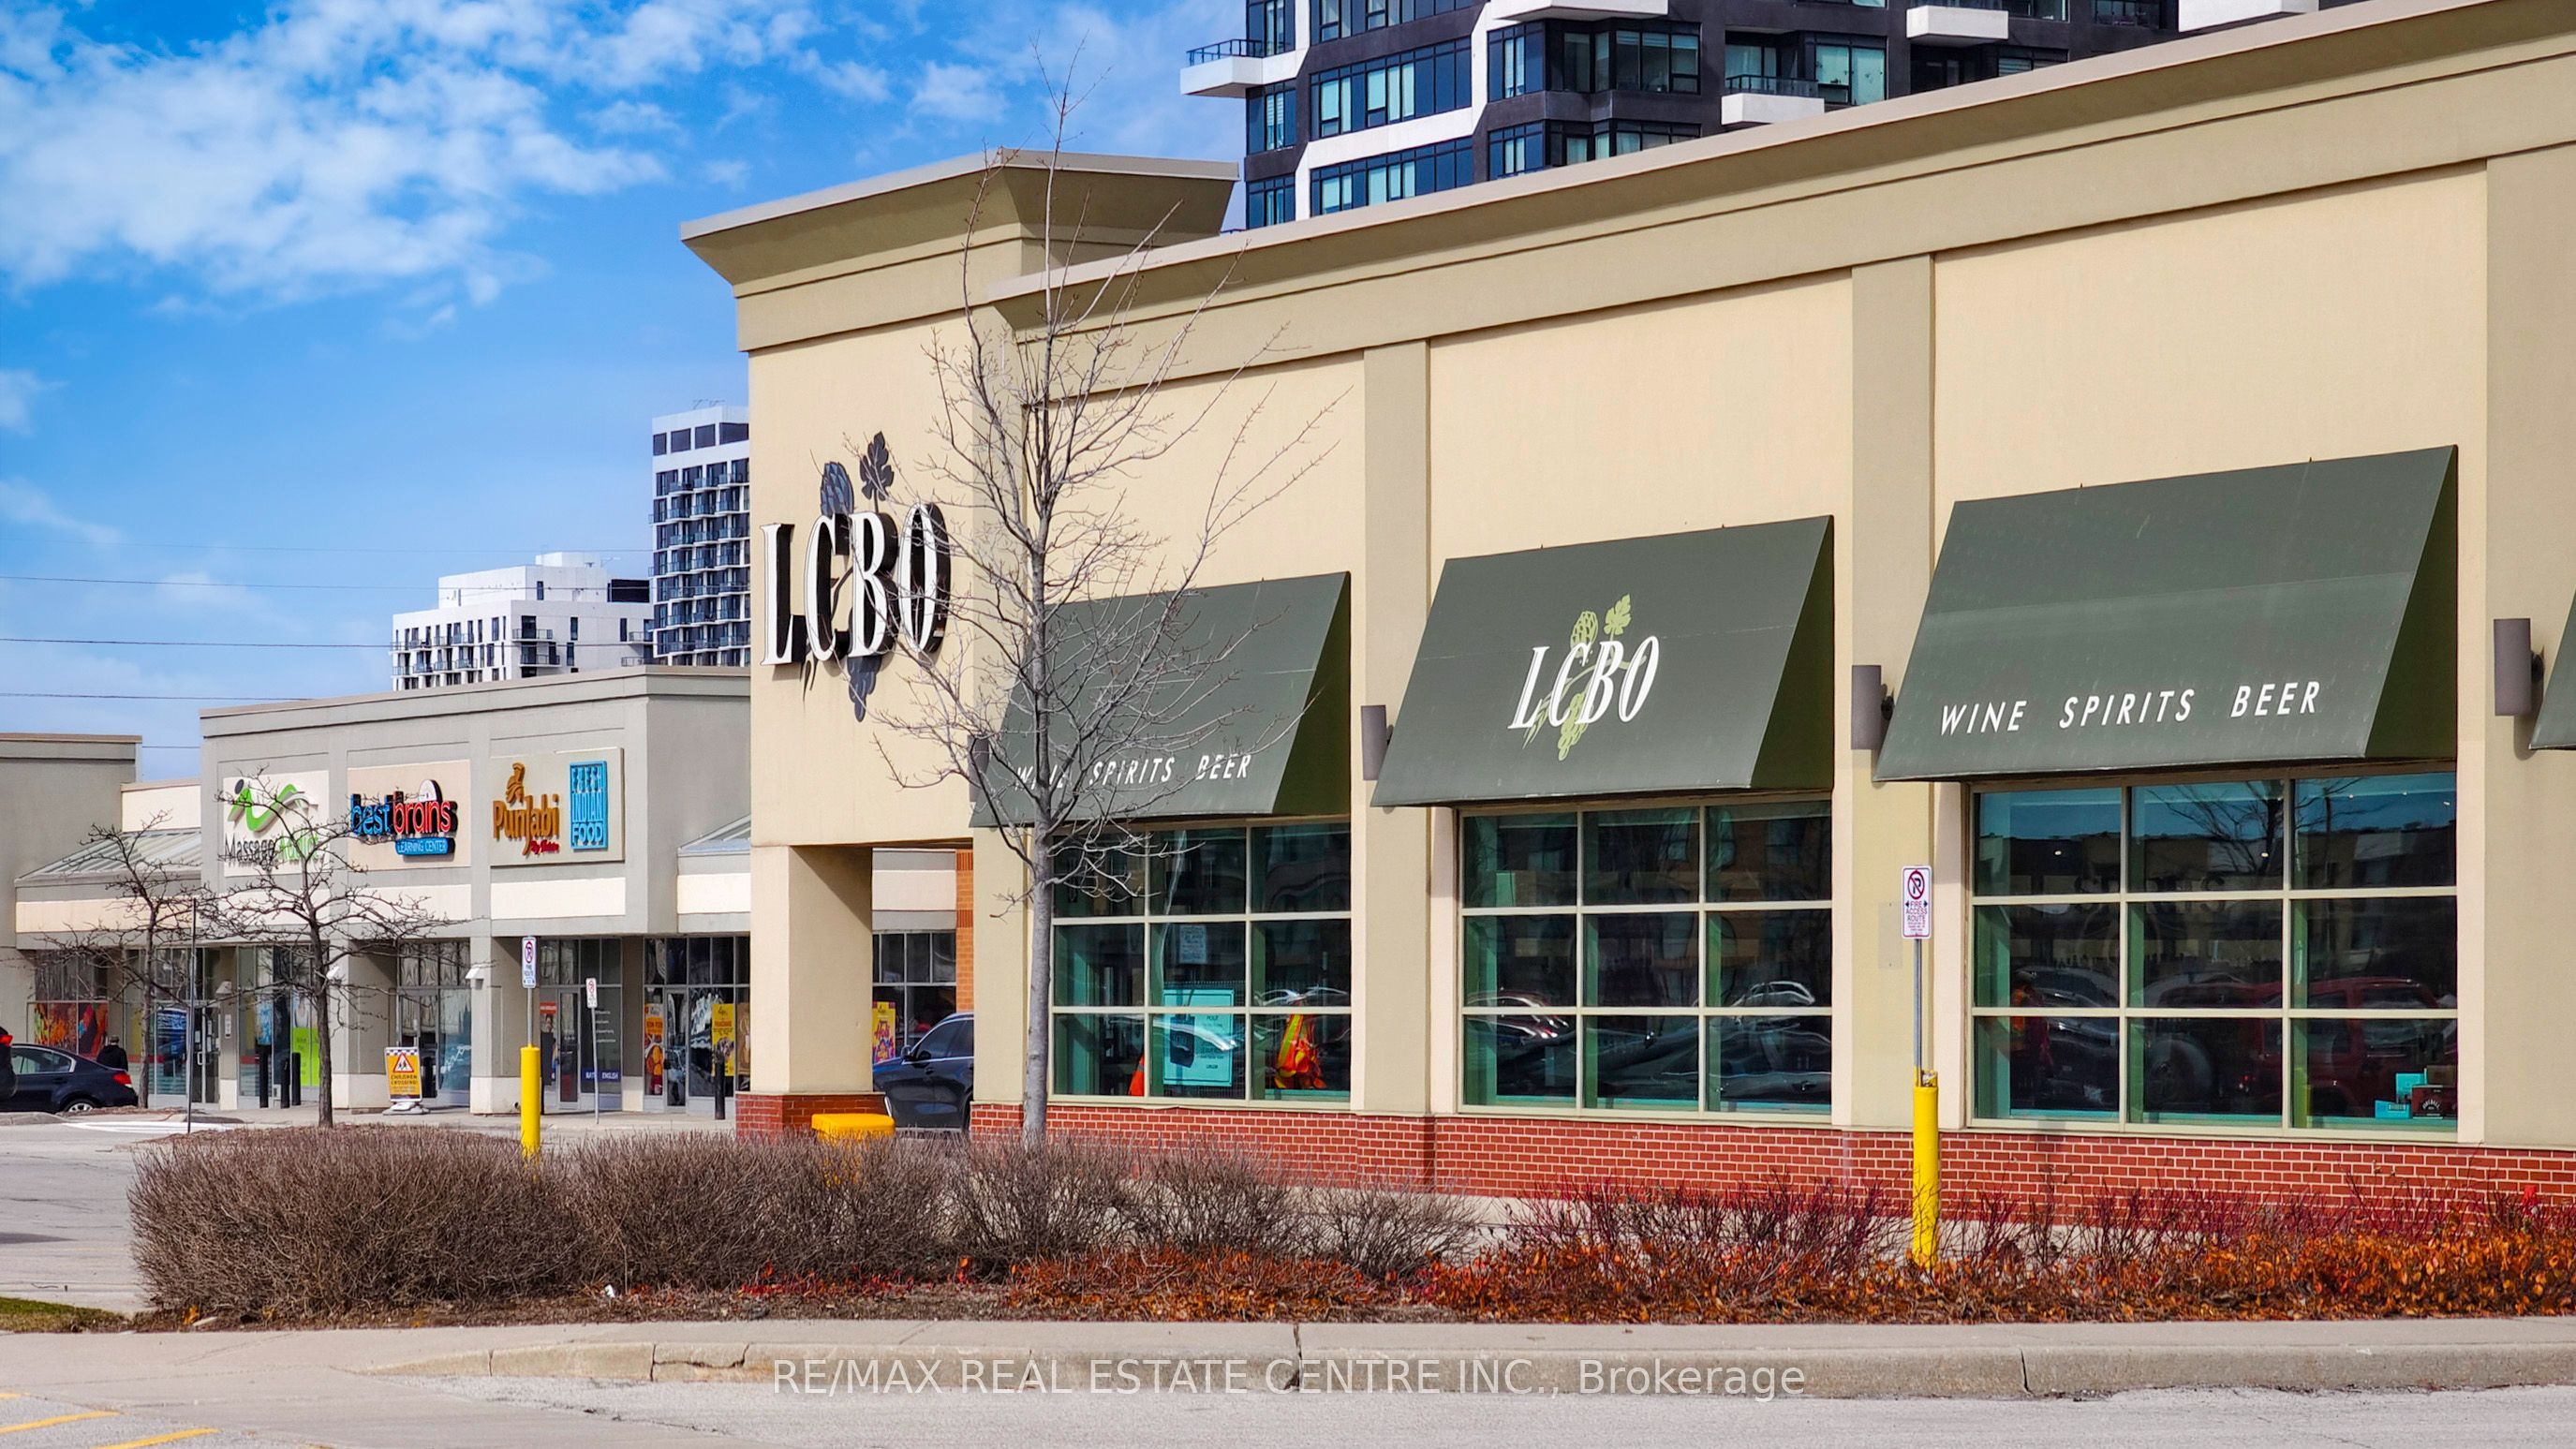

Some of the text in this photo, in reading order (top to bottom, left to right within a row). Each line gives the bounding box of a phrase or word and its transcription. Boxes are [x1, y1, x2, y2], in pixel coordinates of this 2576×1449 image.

[760, 502, 946, 666] LCBO
[1507, 635, 1660, 730] LCBO
[1939, 681, 2322, 735] WINE SPIRITS BEER
[1088, 756, 1176, 787] SPIRITS
[1195, 753, 1251, 781] BEER
[350, 791, 452, 835] best brains
[493, 793, 559, 856] Punjabi
[571, 791, 603, 822] INDIAN
[397, 838, 447, 853] LEARNING CENTER
[571, 822, 603, 846] FOOD
